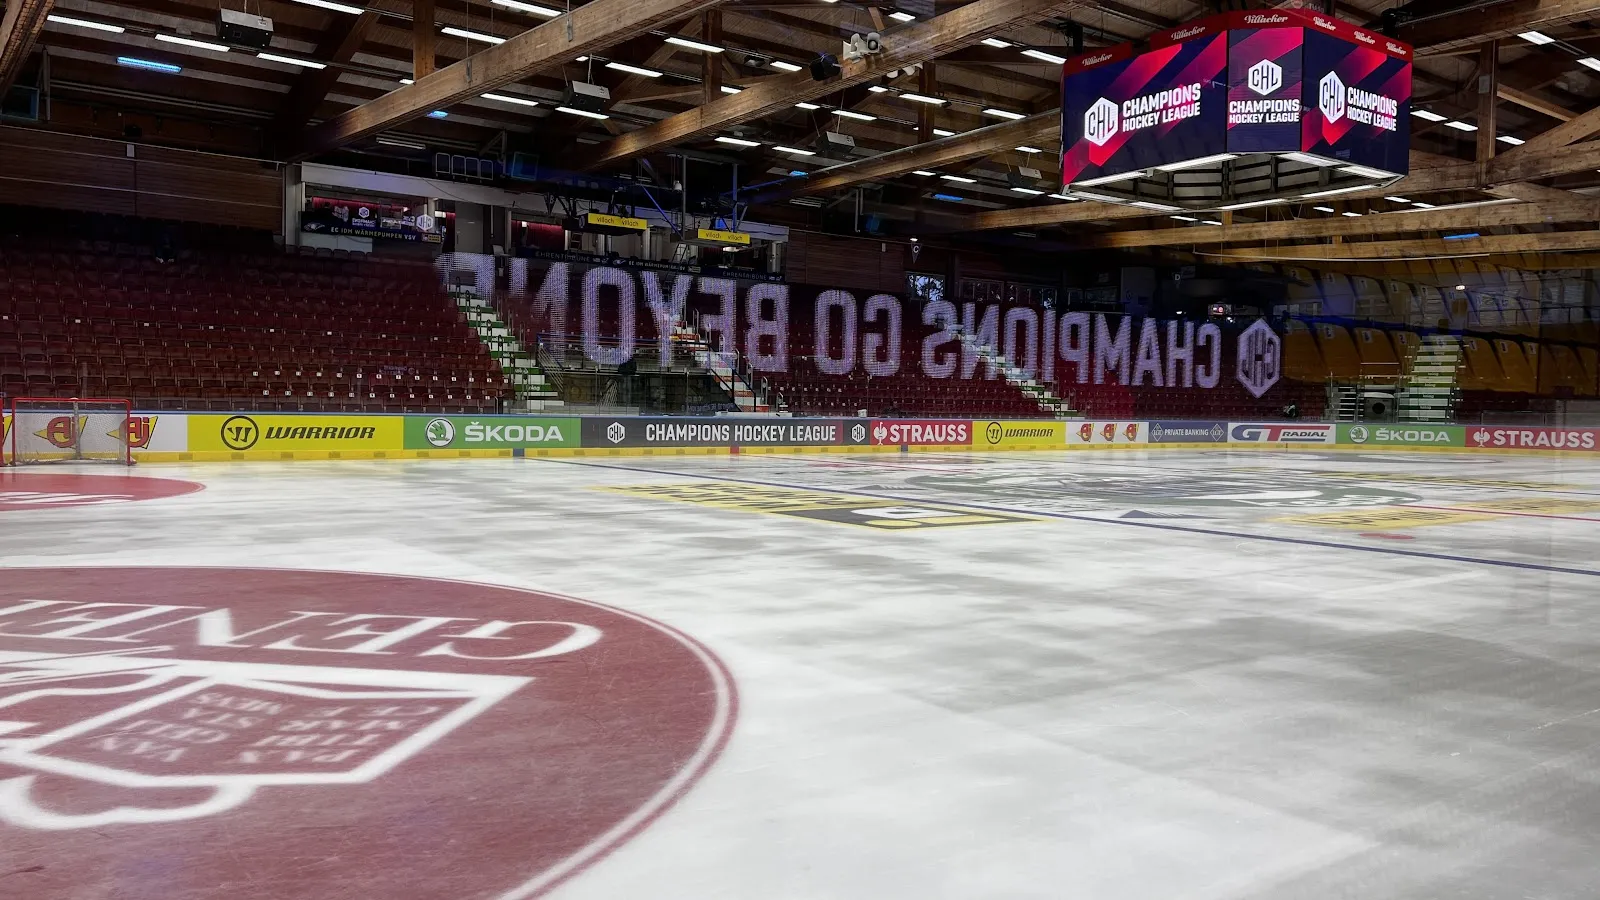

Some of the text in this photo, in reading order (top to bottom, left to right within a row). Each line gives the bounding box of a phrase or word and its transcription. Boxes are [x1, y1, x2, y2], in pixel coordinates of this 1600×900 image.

[1244, 14, 1288, 24] Villacher
[1171, 26, 1206, 40] Villacher
[1251, 63, 1279, 91] CHL
[1123, 82, 1201, 118] CHAMPIONS
[1229, 99, 1300, 114] CHAMPIONS
[1320, 76, 1343, 119] CHL
[1347, 86, 1398, 117] CHAMPIONS
[1088, 102, 1116, 141] CHL
[1122, 102, 1200, 132] HOCKEY LEAGUE
[1229, 112, 1300, 124] HOCKEY LEAGUE
[1347, 106, 1397, 132] HOCKEY LEAGUE
[596, 216, 639, 228] villach villach
[706, 230, 722, 239] villach
[265, 426, 376, 439] WARRIOR
[464, 421, 564, 442] ŠKODA
[608, 424, 626, 442] CHL
[646, 424, 836, 442] CHAMPIONS HOCKEY LEAGUE
[852, 424, 866, 442] CHL
[890, 424, 967, 442] STRAUSS
[1004, 428, 1054, 438] WARRIOR
[1232, 424, 1330, 442] GT
[1375, 428, 1451, 442] ŠKODA
[1492, 430, 1596, 449] STRAUSS
